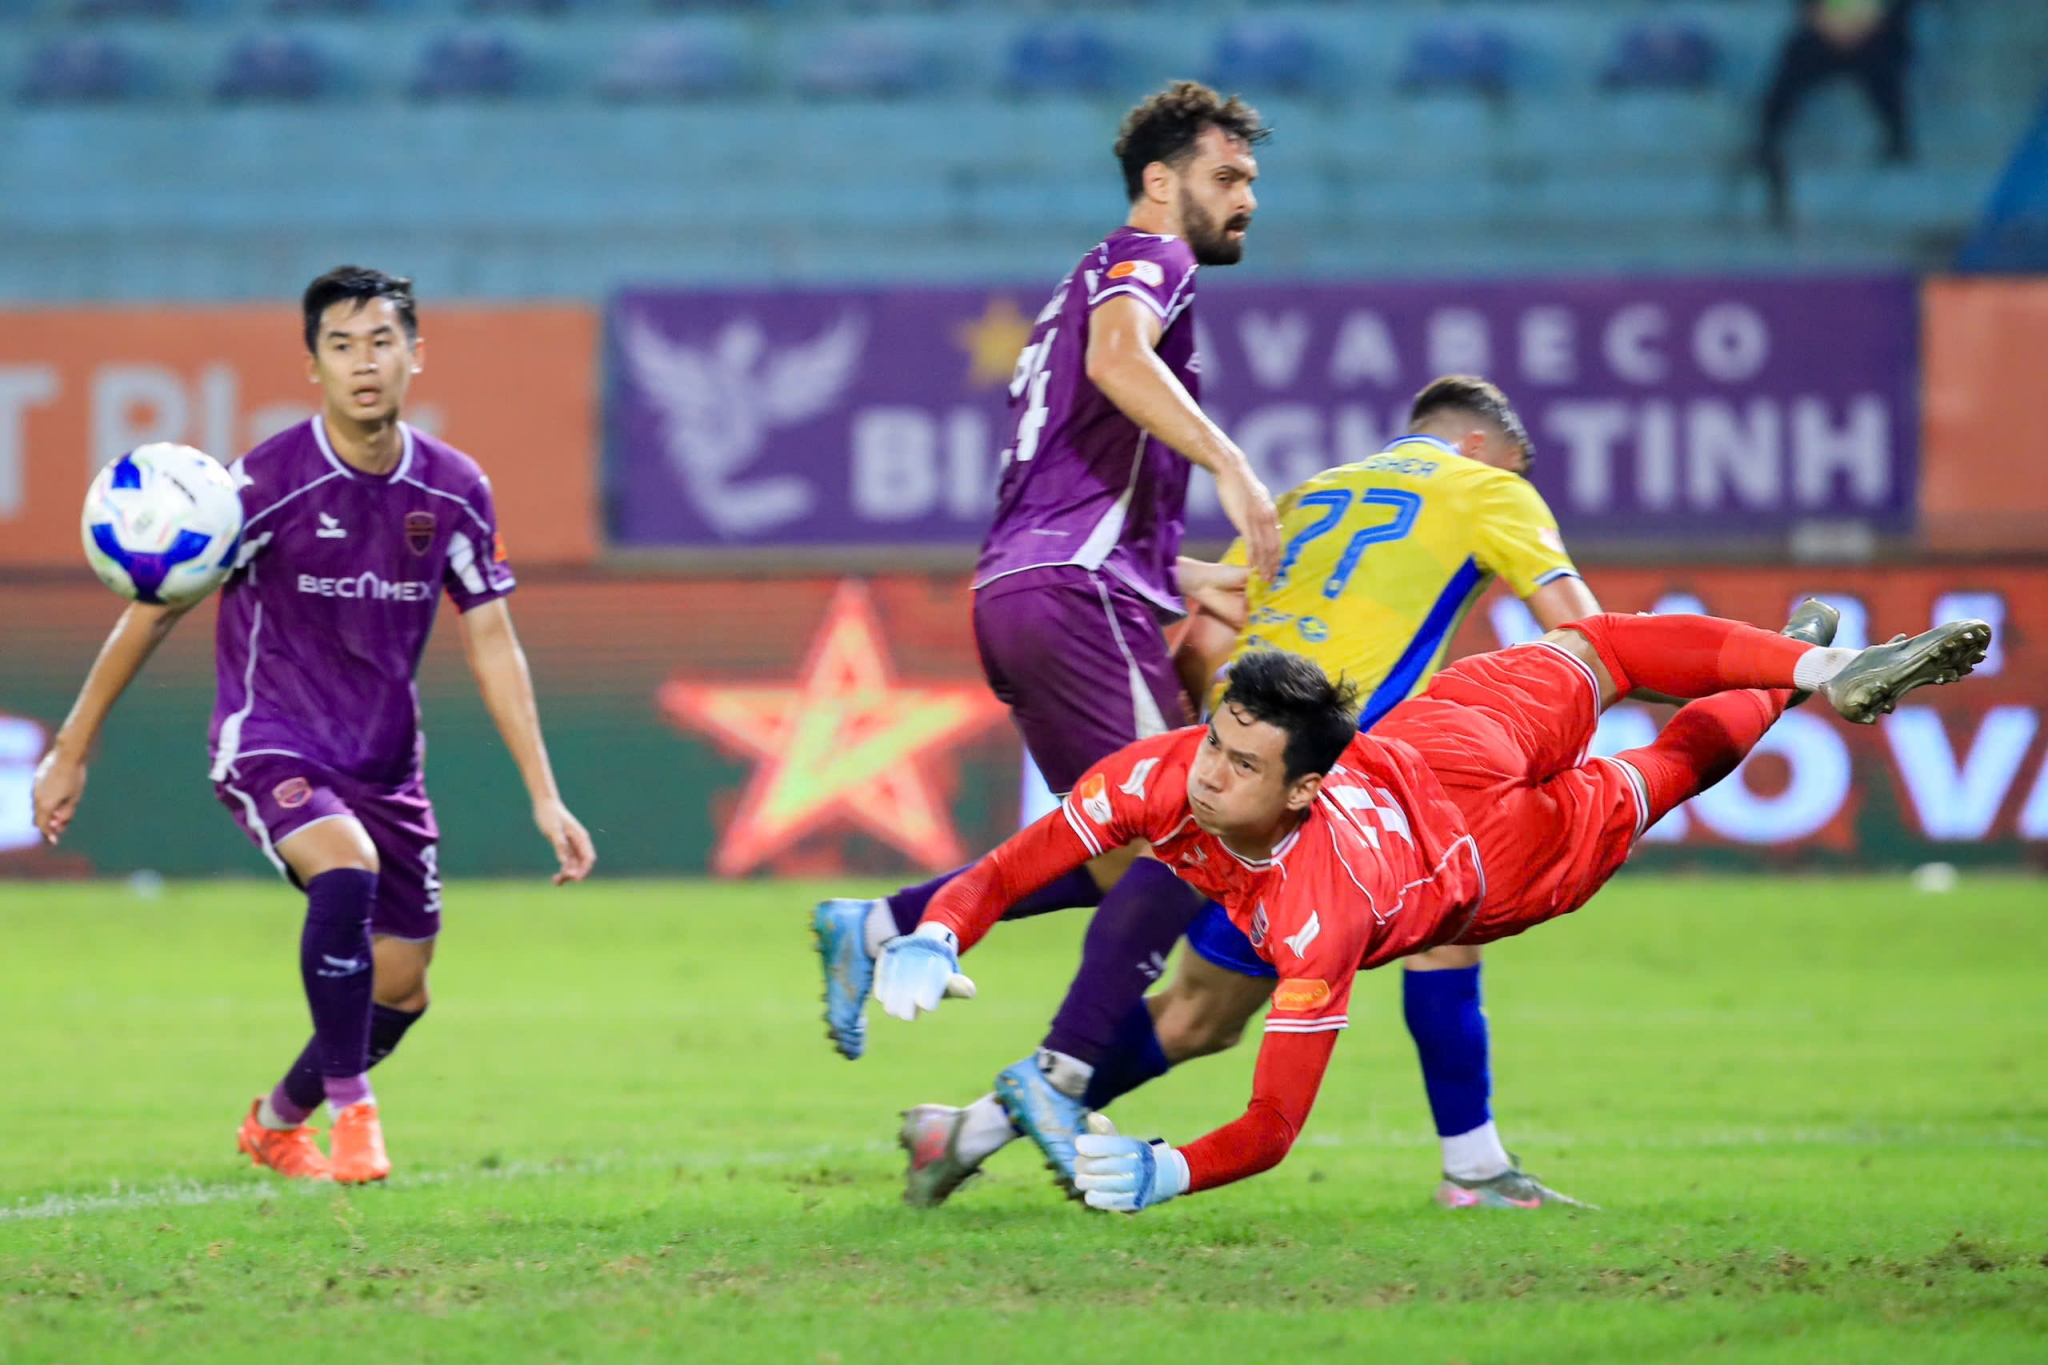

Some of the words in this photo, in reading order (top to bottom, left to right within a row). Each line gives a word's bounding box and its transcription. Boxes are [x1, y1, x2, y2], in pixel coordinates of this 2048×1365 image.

[1550, 398, 1892, 514] TINH
[297, 570, 434, 601] BECAMEX
[1270, 487, 1424, 600] 77
